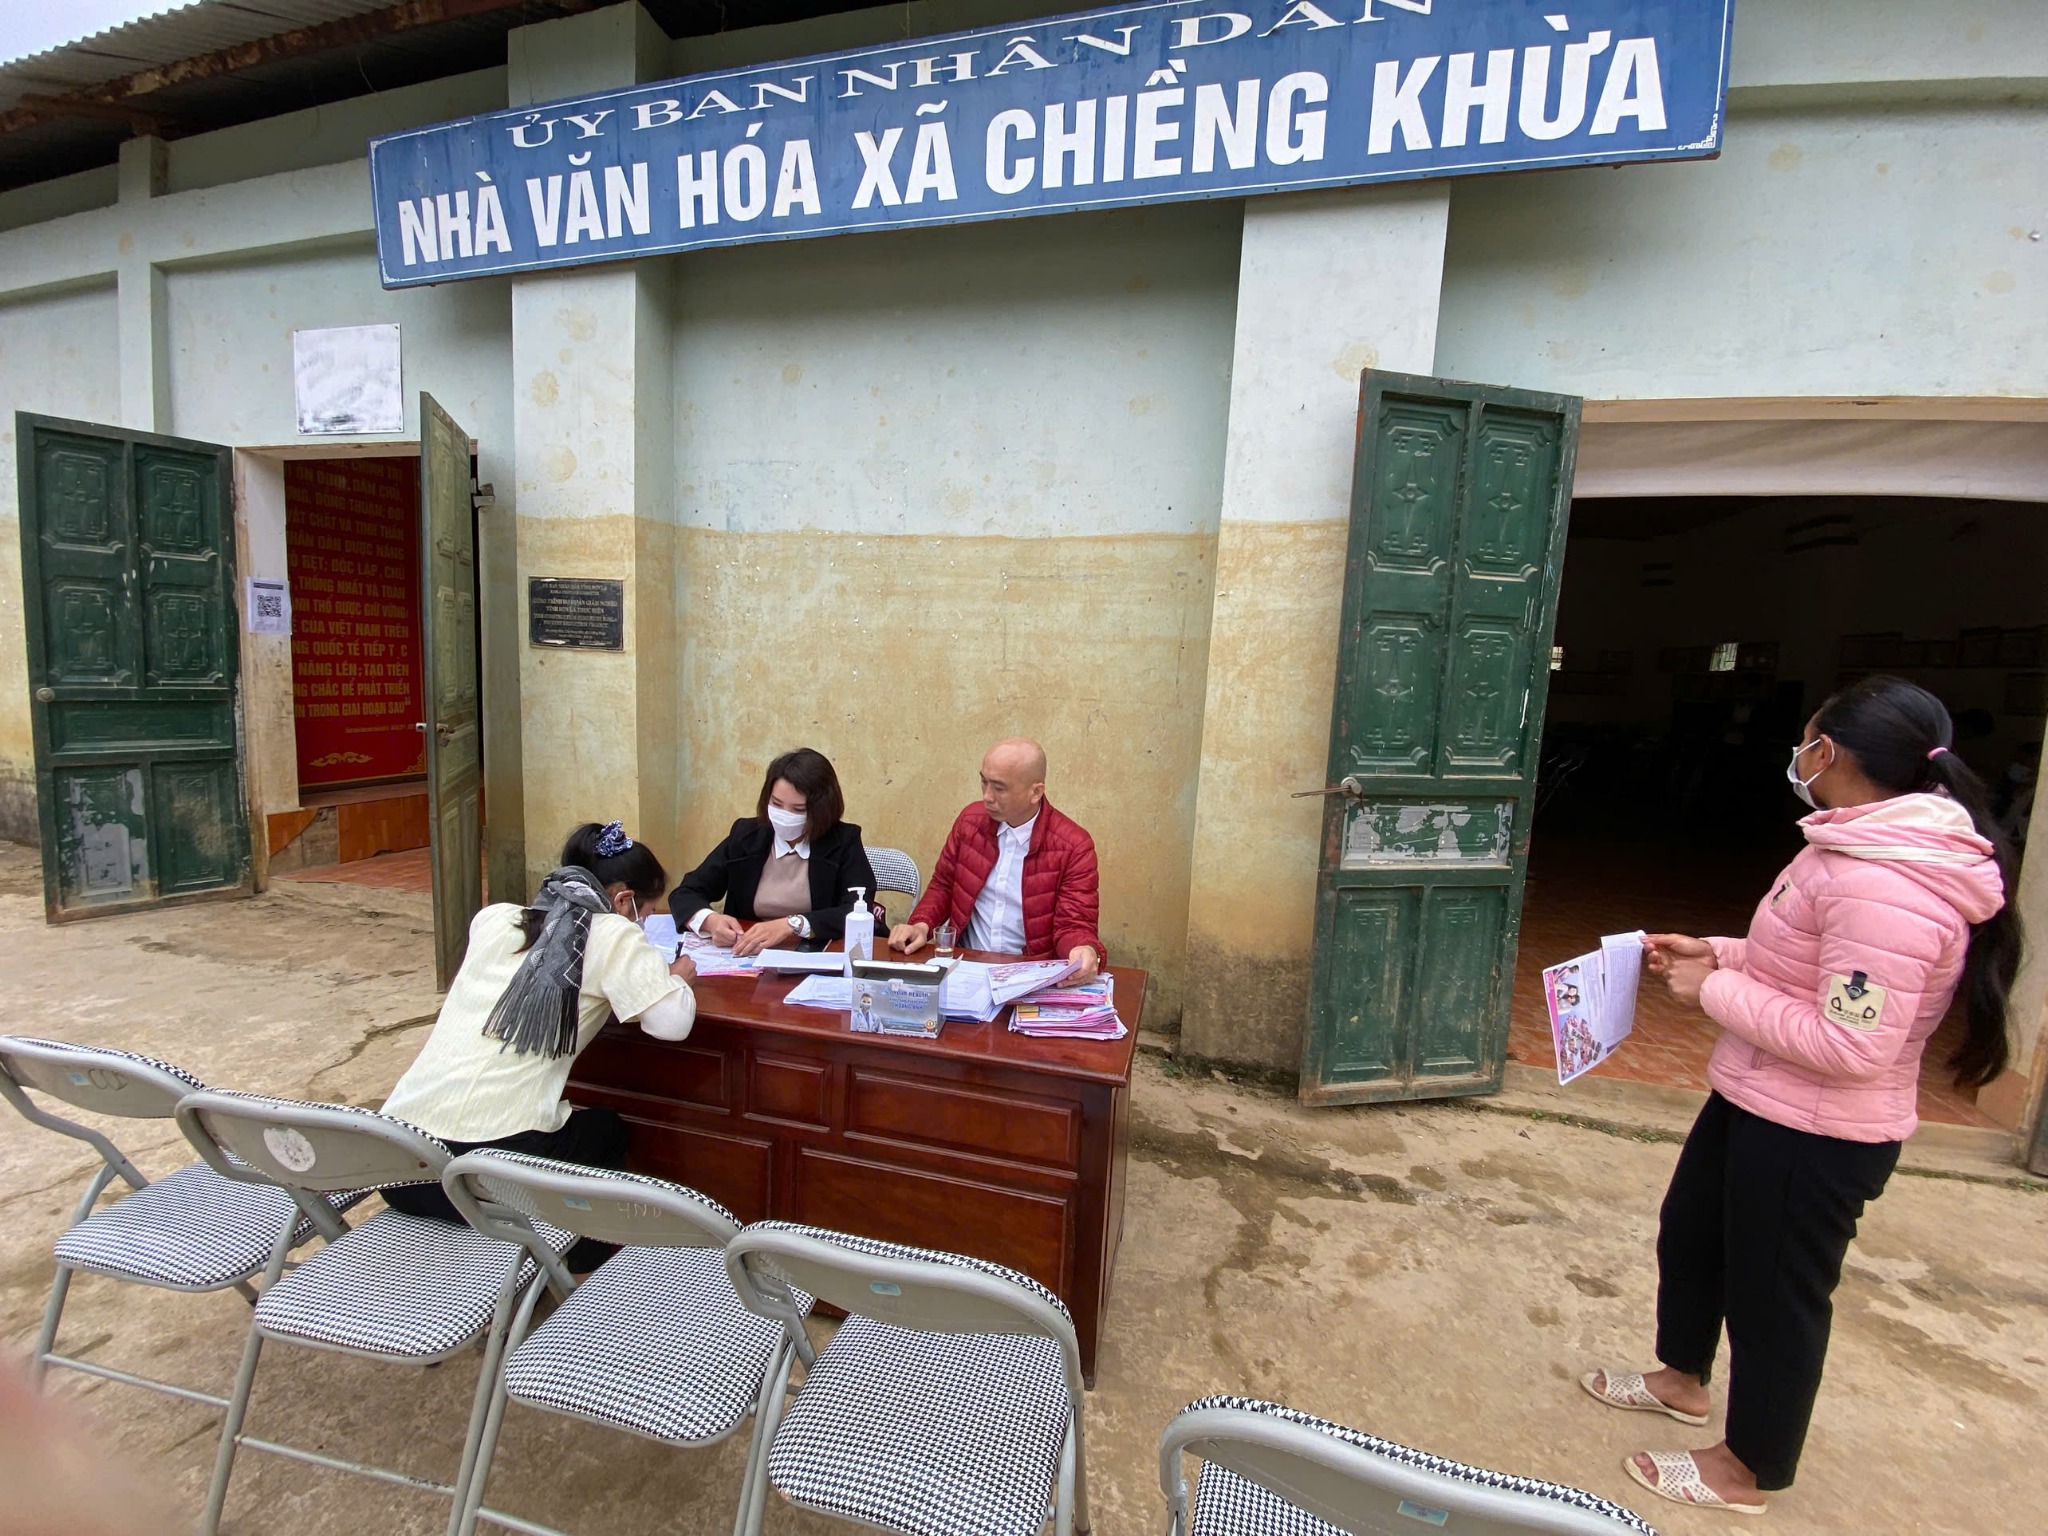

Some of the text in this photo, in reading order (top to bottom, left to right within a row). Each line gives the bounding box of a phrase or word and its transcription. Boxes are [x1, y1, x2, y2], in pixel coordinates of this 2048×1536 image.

[506, 113, 615, 149] ỦY
[629, 75, 815, 131] BAN
[837, 25, 1143, 98] NHÂN
[398, 15, 1668, 267] NHÀ VĂN HÓA XÃ CHIỀNG KHỪA
[301, 616, 326, 634] CỦA
[328, 618, 353, 638] VIỆT
[355, 622, 381, 637] NAM
[313, 637, 345, 657] QUỐC
[346, 638, 360, 656] TẾ
[363, 639, 386, 657] TIẾP
[298, 659, 333, 676] NÂNG
[357, 679, 382, 696] PHÁT
[308, 703, 340, 718] TRONG
